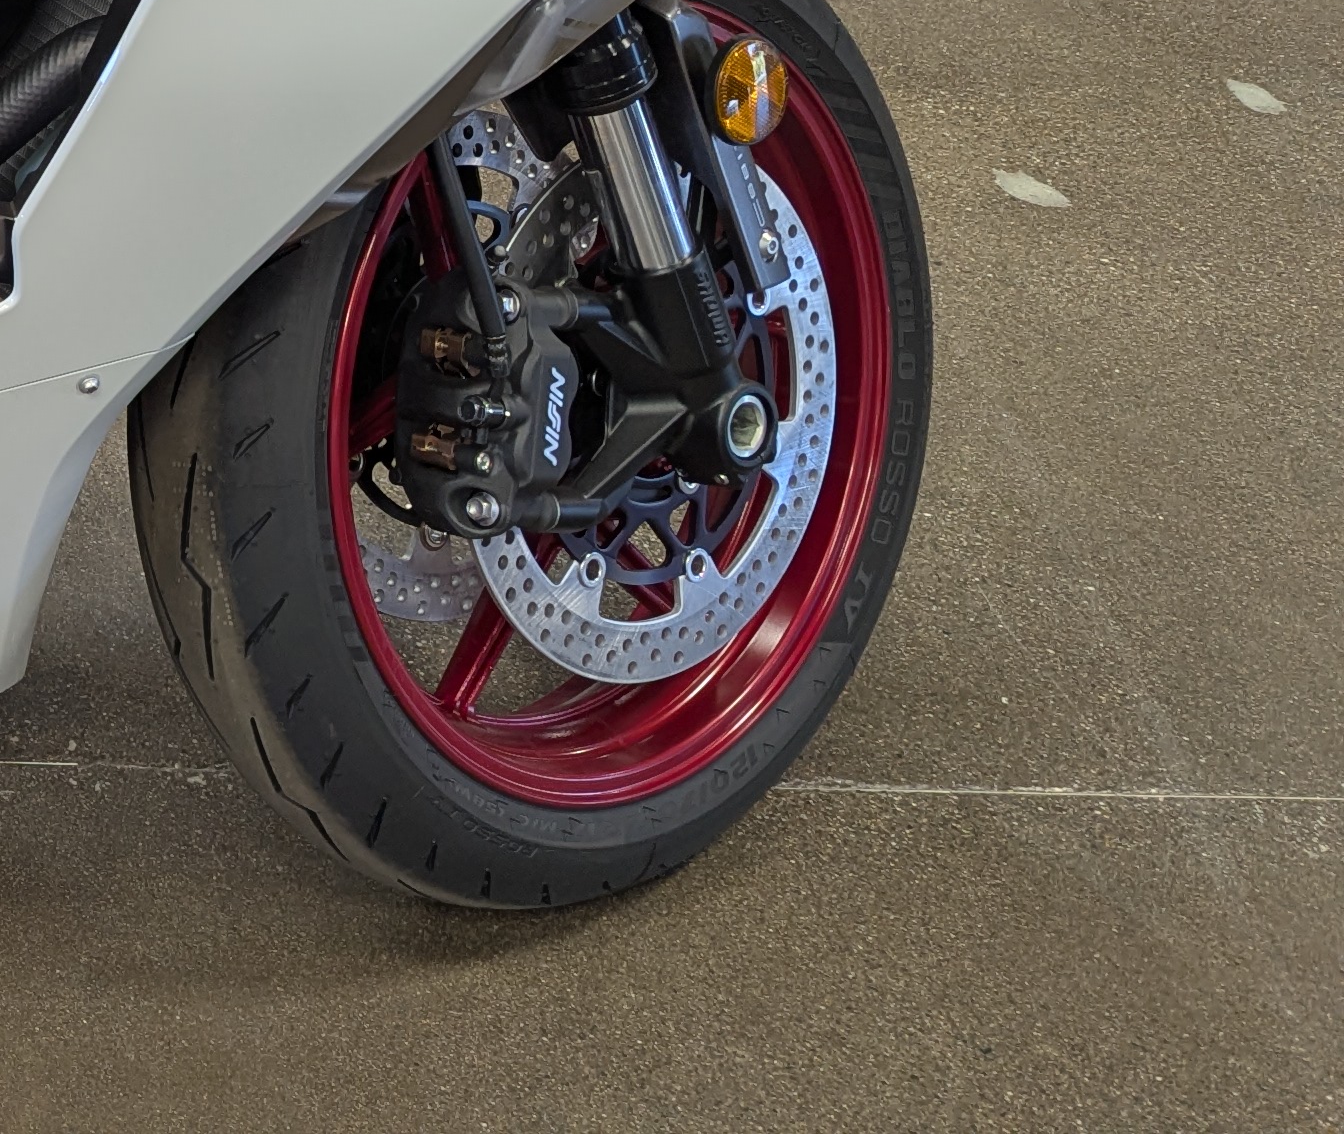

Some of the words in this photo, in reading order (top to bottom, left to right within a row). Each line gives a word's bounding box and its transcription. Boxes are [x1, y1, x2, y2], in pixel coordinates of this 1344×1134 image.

[697, 269, 734, 346] SHOWA
[881, 208, 917, 381] DIABLO
[870, 398, 914, 546] ROSSO
